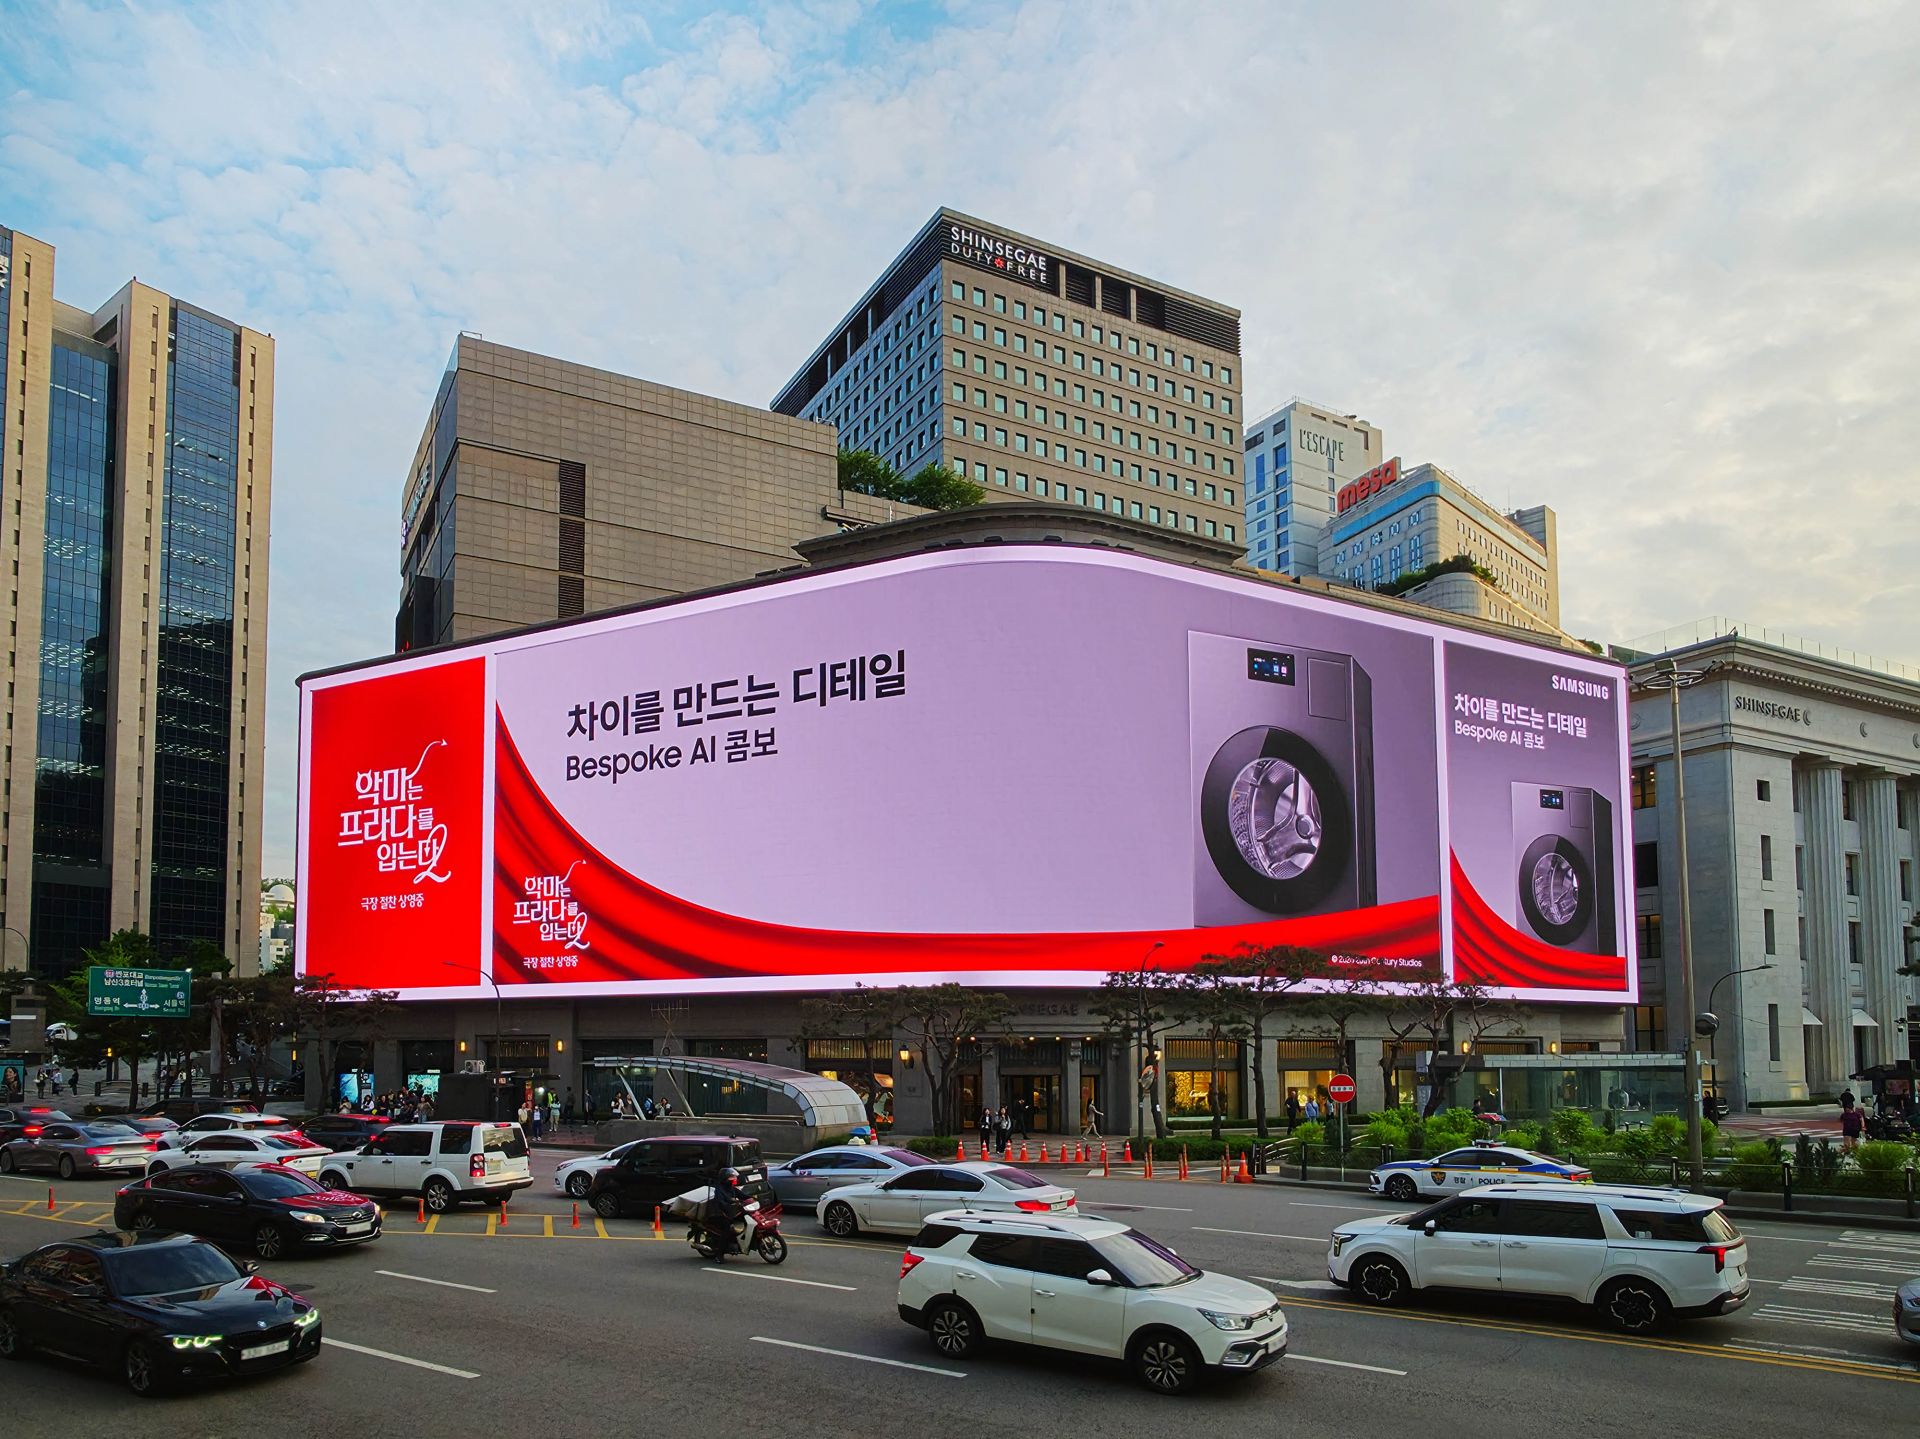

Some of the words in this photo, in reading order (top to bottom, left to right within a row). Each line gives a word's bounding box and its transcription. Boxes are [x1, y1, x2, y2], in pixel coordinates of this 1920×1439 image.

[951, 227, 1047, 270] SHINSEGAE
[951, 244, 992, 265] DUTY
[1006, 261, 1047, 284] FREE
[1300, 429, 1344, 462] L'ESCAPE
[1337, 460, 1397, 513] mesa
[566, 690, 665, 741] 차이를
[673, 674, 780, 728] 만드는
[793, 649, 906, 707] 디테일
[1551, 675, 1609, 700] SAMSUNG
[1454, 693, 1500, 722] 차이를
[1501, 703, 1545, 730] 만드는
[1547, 712, 1588, 738] 디테일
[1735, 696, 1801, 723] SHINSEGAE
[1454, 720, 1507, 742] Bespoke
[1509, 732, 1521, 745] AI
[1523, 732, 1545, 749] 콤보
[566, 744, 682, 784] Bespoke
[689, 735, 717, 765] AI
[724, 727, 778, 763] 콤보
[338, 804, 434, 846] 프라다를
[360, 897, 378, 911] 극장
[398, 892, 424, 909] 상영중
[513, 899, 578, 924] 프라다를
[523, 957, 538, 969] 극장
[1399, 957, 1422, 968] Studios
[1478, 1177, 1505, 1186] POLICE
